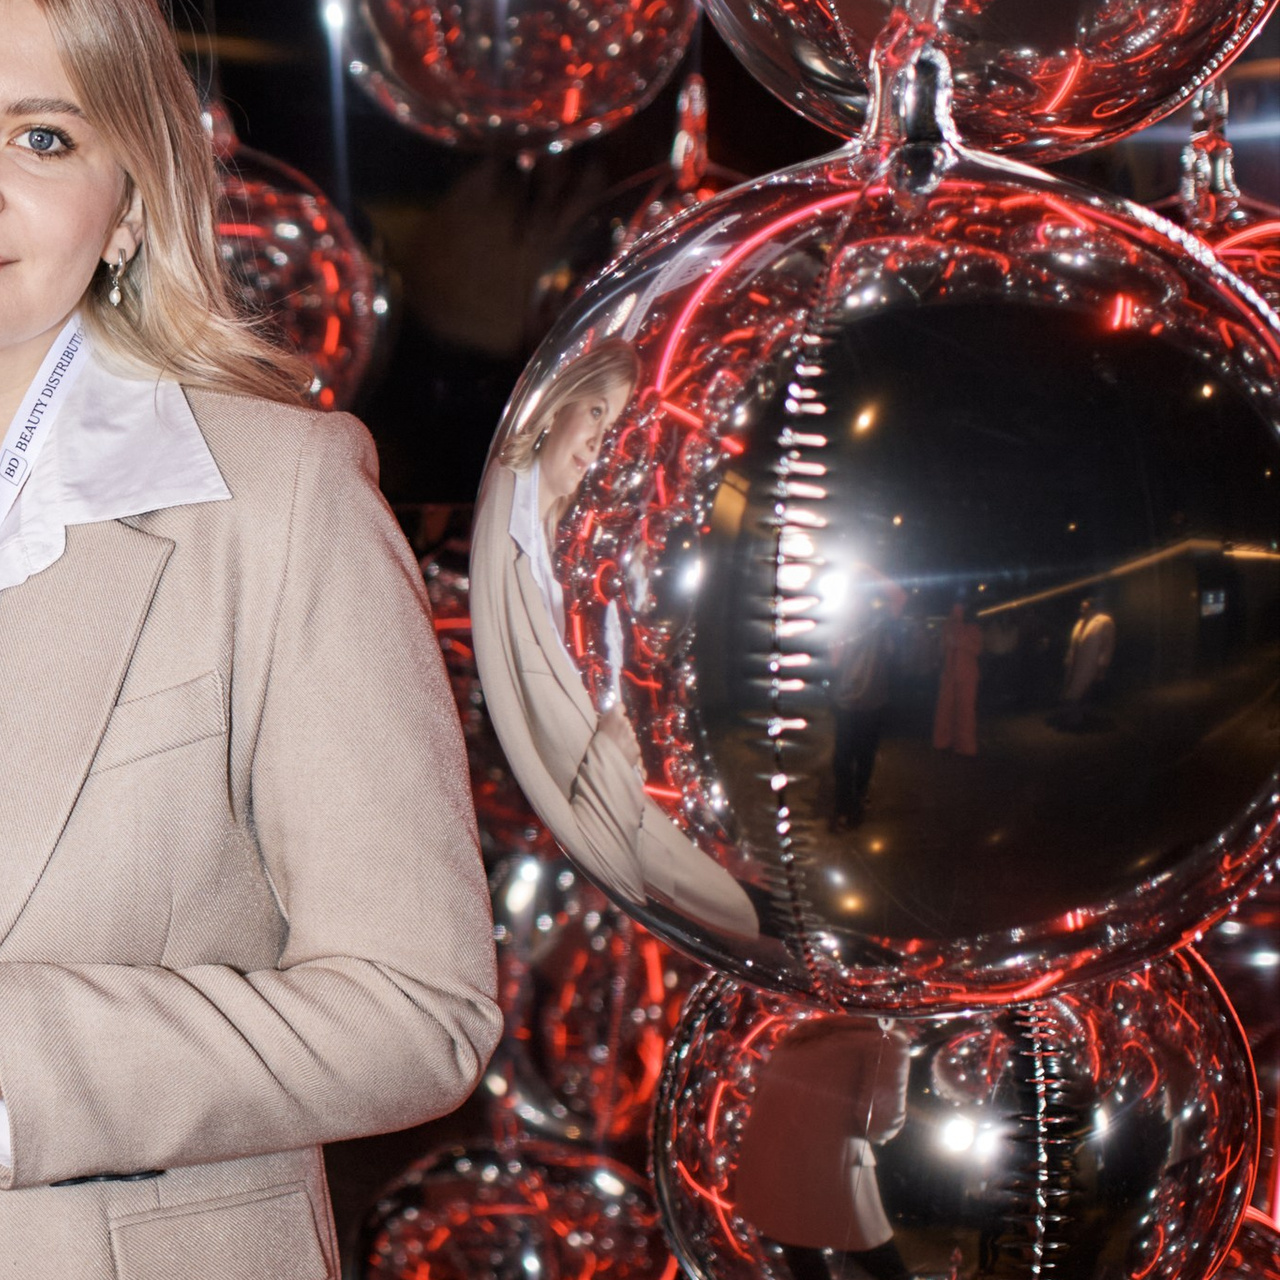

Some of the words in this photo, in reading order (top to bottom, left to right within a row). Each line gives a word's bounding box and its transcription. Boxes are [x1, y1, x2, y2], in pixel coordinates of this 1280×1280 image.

[4, 456, 21, 479] BD
[15, 398, 49, 453] BEAUTY
[40, 325, 86, 399] DISTRIBUTIO
